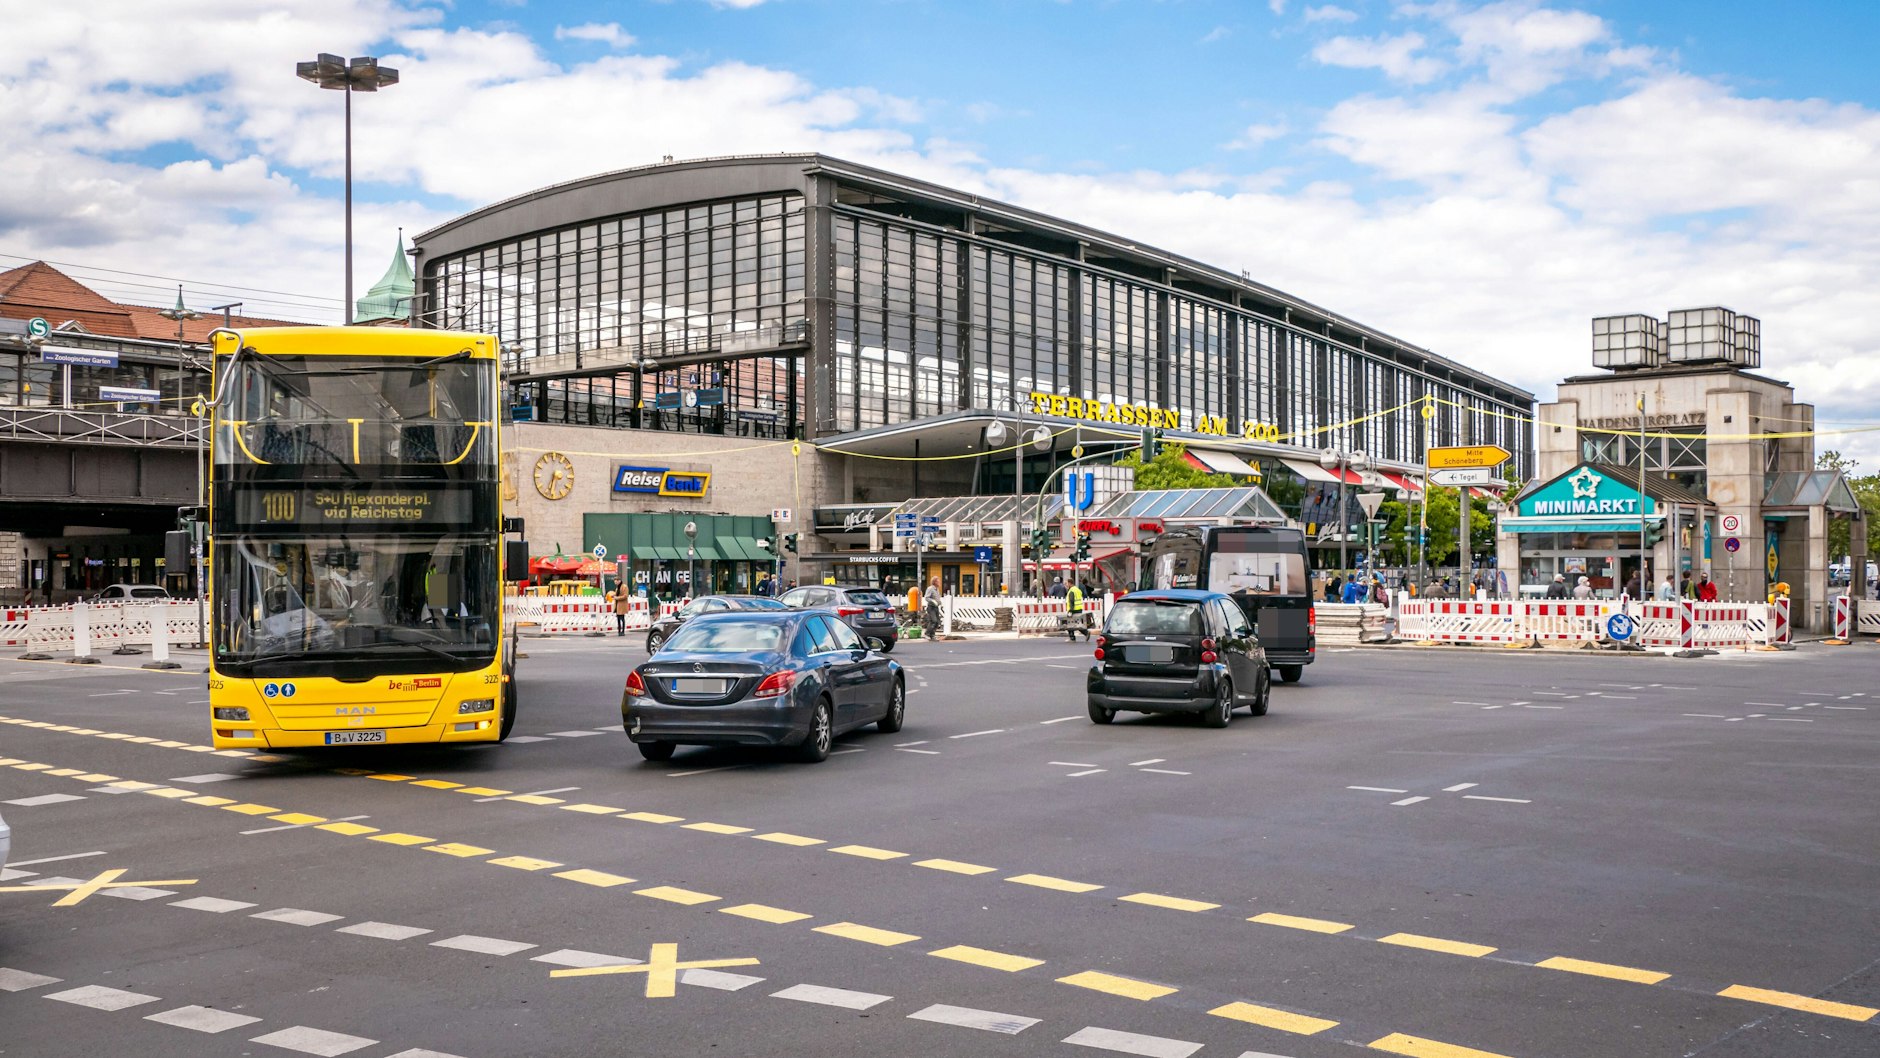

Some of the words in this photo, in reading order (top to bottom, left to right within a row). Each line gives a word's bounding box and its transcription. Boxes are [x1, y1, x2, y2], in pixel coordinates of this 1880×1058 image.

[54, 354, 91, 362] Zoologischer
[667, 376, 672, 385] 2
[690, 374, 696, 382] A
[1030, 391, 1180, 429] TERRASSEN
[1197, 415, 1228, 436] AM
[1244, 420, 1279, 443] ZOO
[621, 471, 661, 487] Reise
[666, 476, 701, 492] Bank
[1069, 473, 1094, 510] U
[315, 493, 340, 505] S+U
[343, 493, 431, 506] Alexanderpl.
[262, 492, 296, 521] 100
[1534, 499, 1637, 514] MINIMARKT
[325, 507, 348, 518] via
[351, 506, 423, 519] Reichstag
[1726, 519, 1736, 527] 20
[389, 680, 402, 690] be
[418, 679, 440, 688] Berlin
[484, 675, 499, 684] 3225
[336, 706, 376, 715] MAN
[335, 733, 341, 743] B
[348, 733, 354, 742] V
[357, 732, 382, 742] 3225
